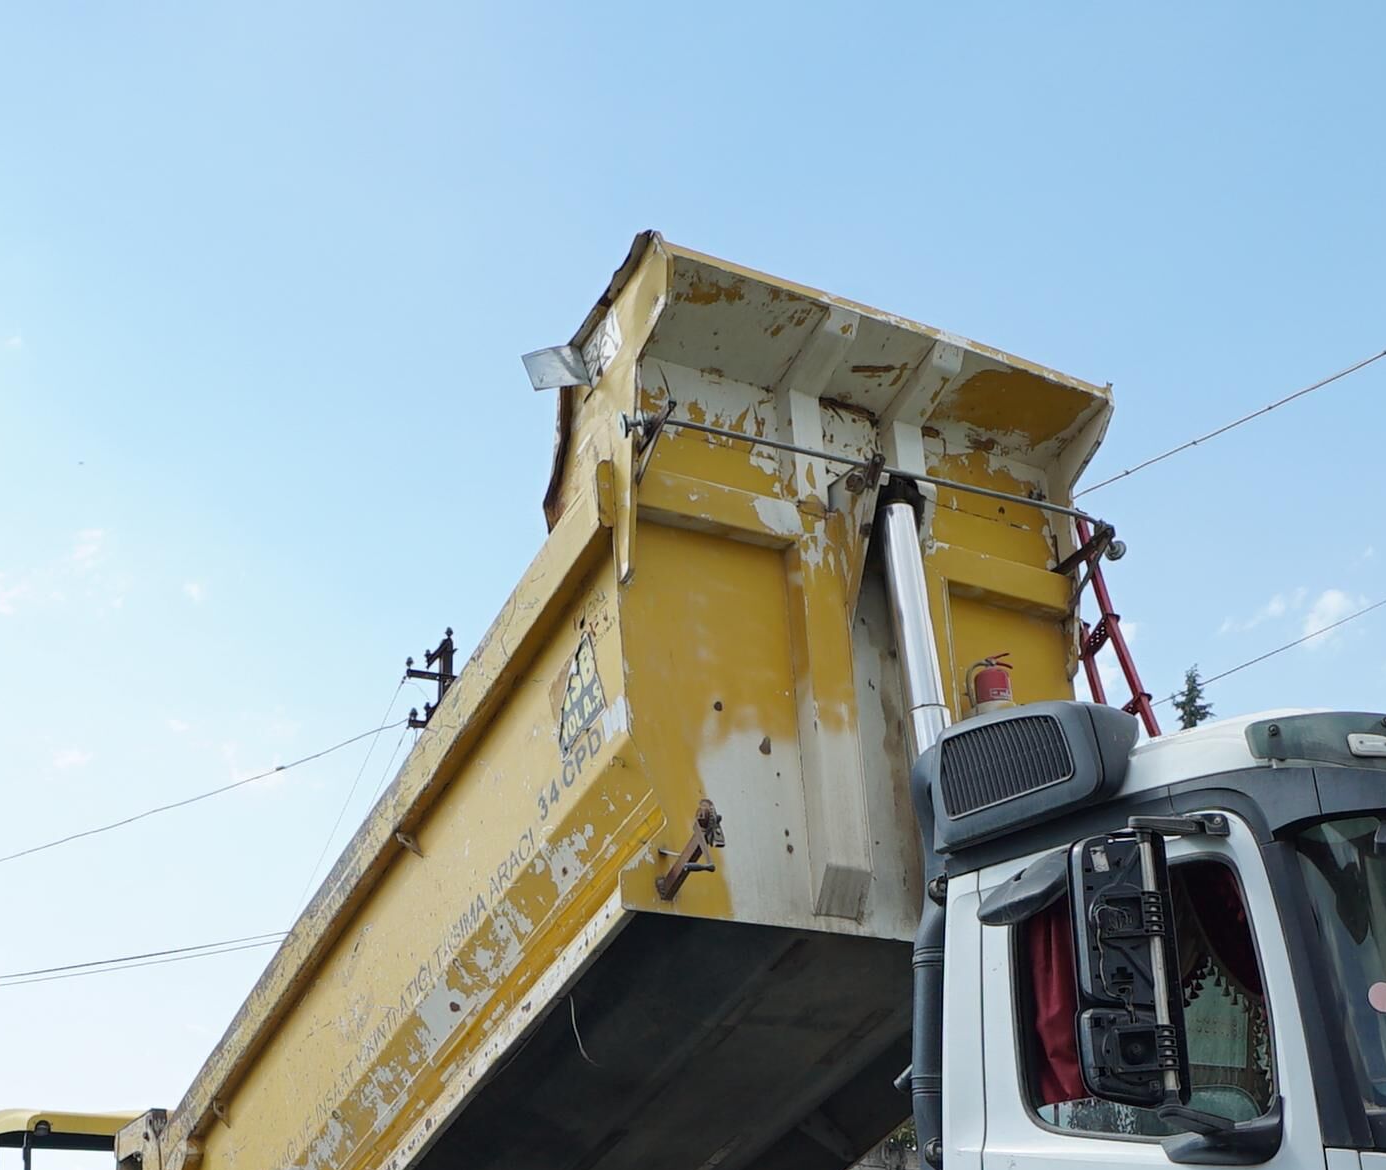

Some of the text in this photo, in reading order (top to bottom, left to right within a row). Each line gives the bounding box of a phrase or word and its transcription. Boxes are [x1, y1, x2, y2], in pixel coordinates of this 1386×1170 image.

[487, 826, 536, 902] ARACI
[536, 777, 561, 821] 34
[561, 727, 603, 789] CPD
